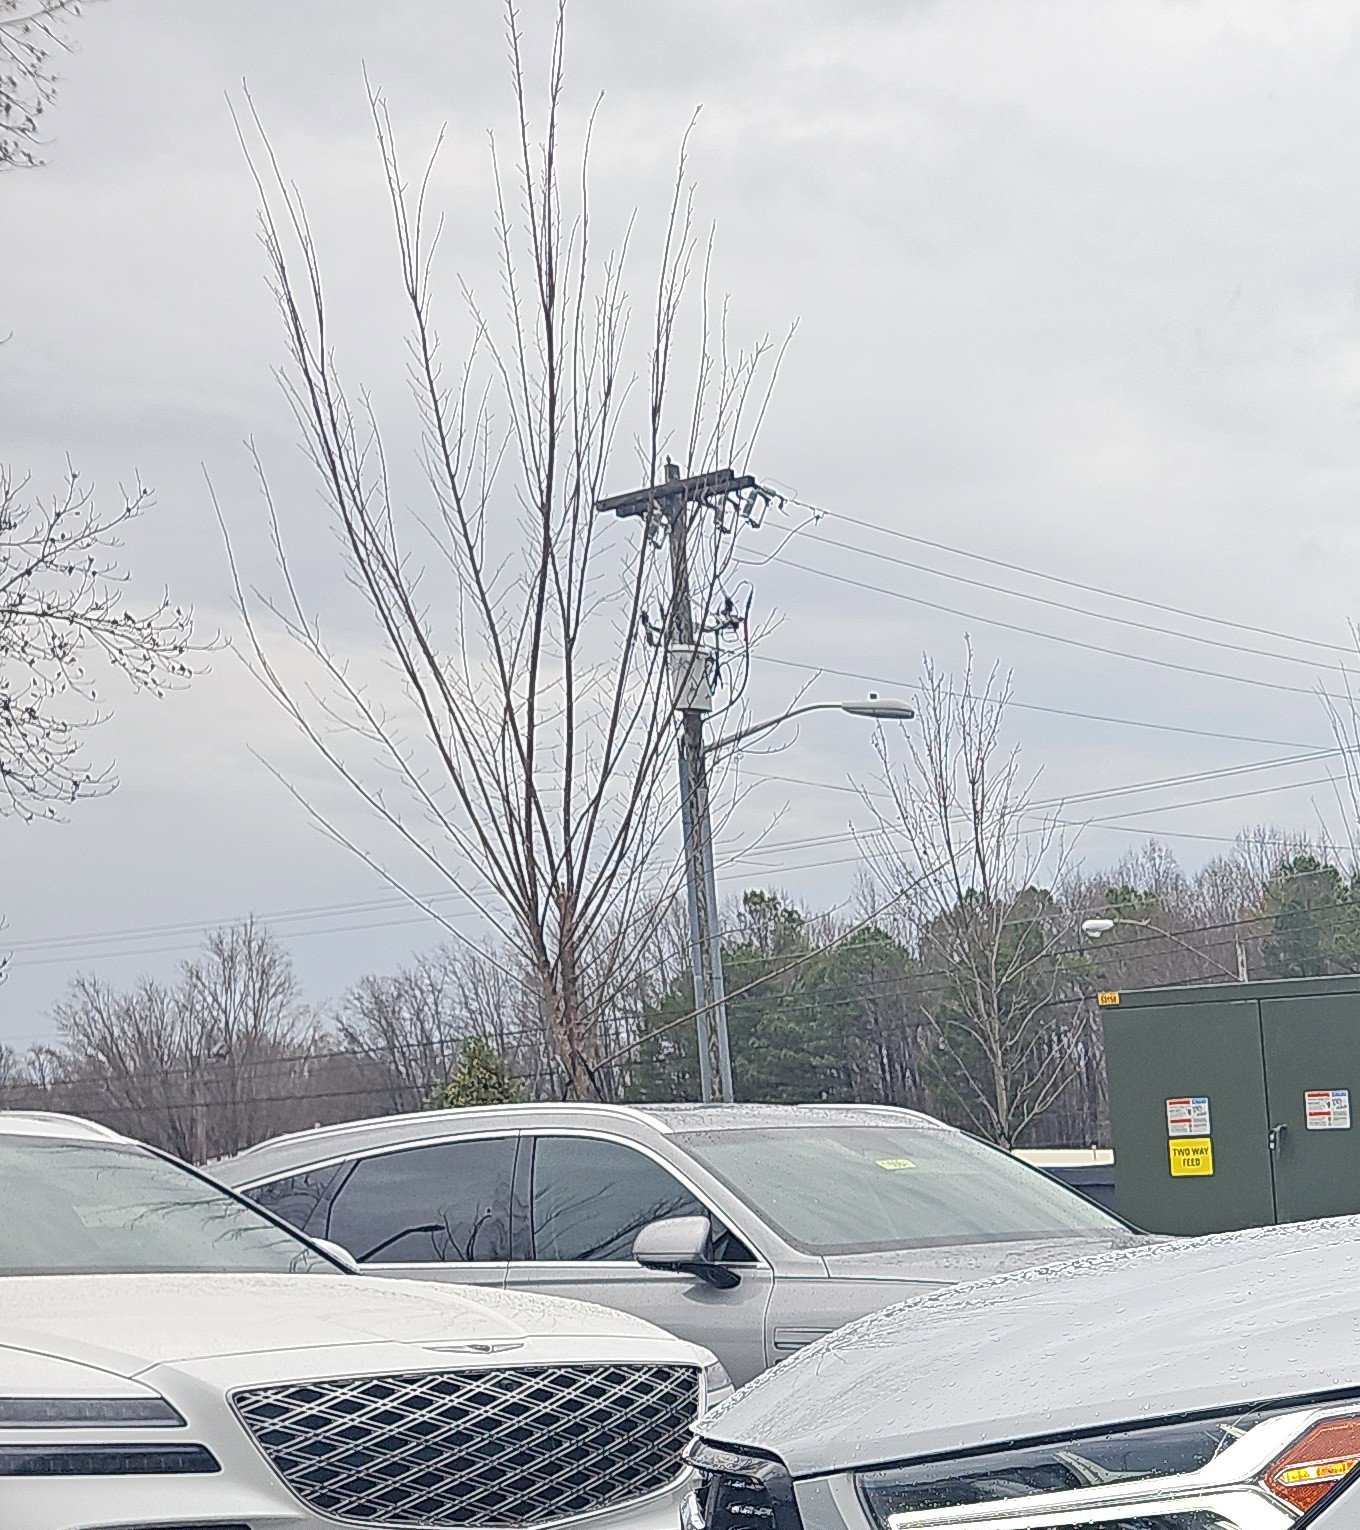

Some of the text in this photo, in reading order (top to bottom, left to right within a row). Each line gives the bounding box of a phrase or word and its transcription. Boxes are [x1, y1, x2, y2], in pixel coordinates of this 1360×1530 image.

[1172, 1146, 1209, 1157] TWO WAY
[1183, 1158, 1201, 1168] FEED
